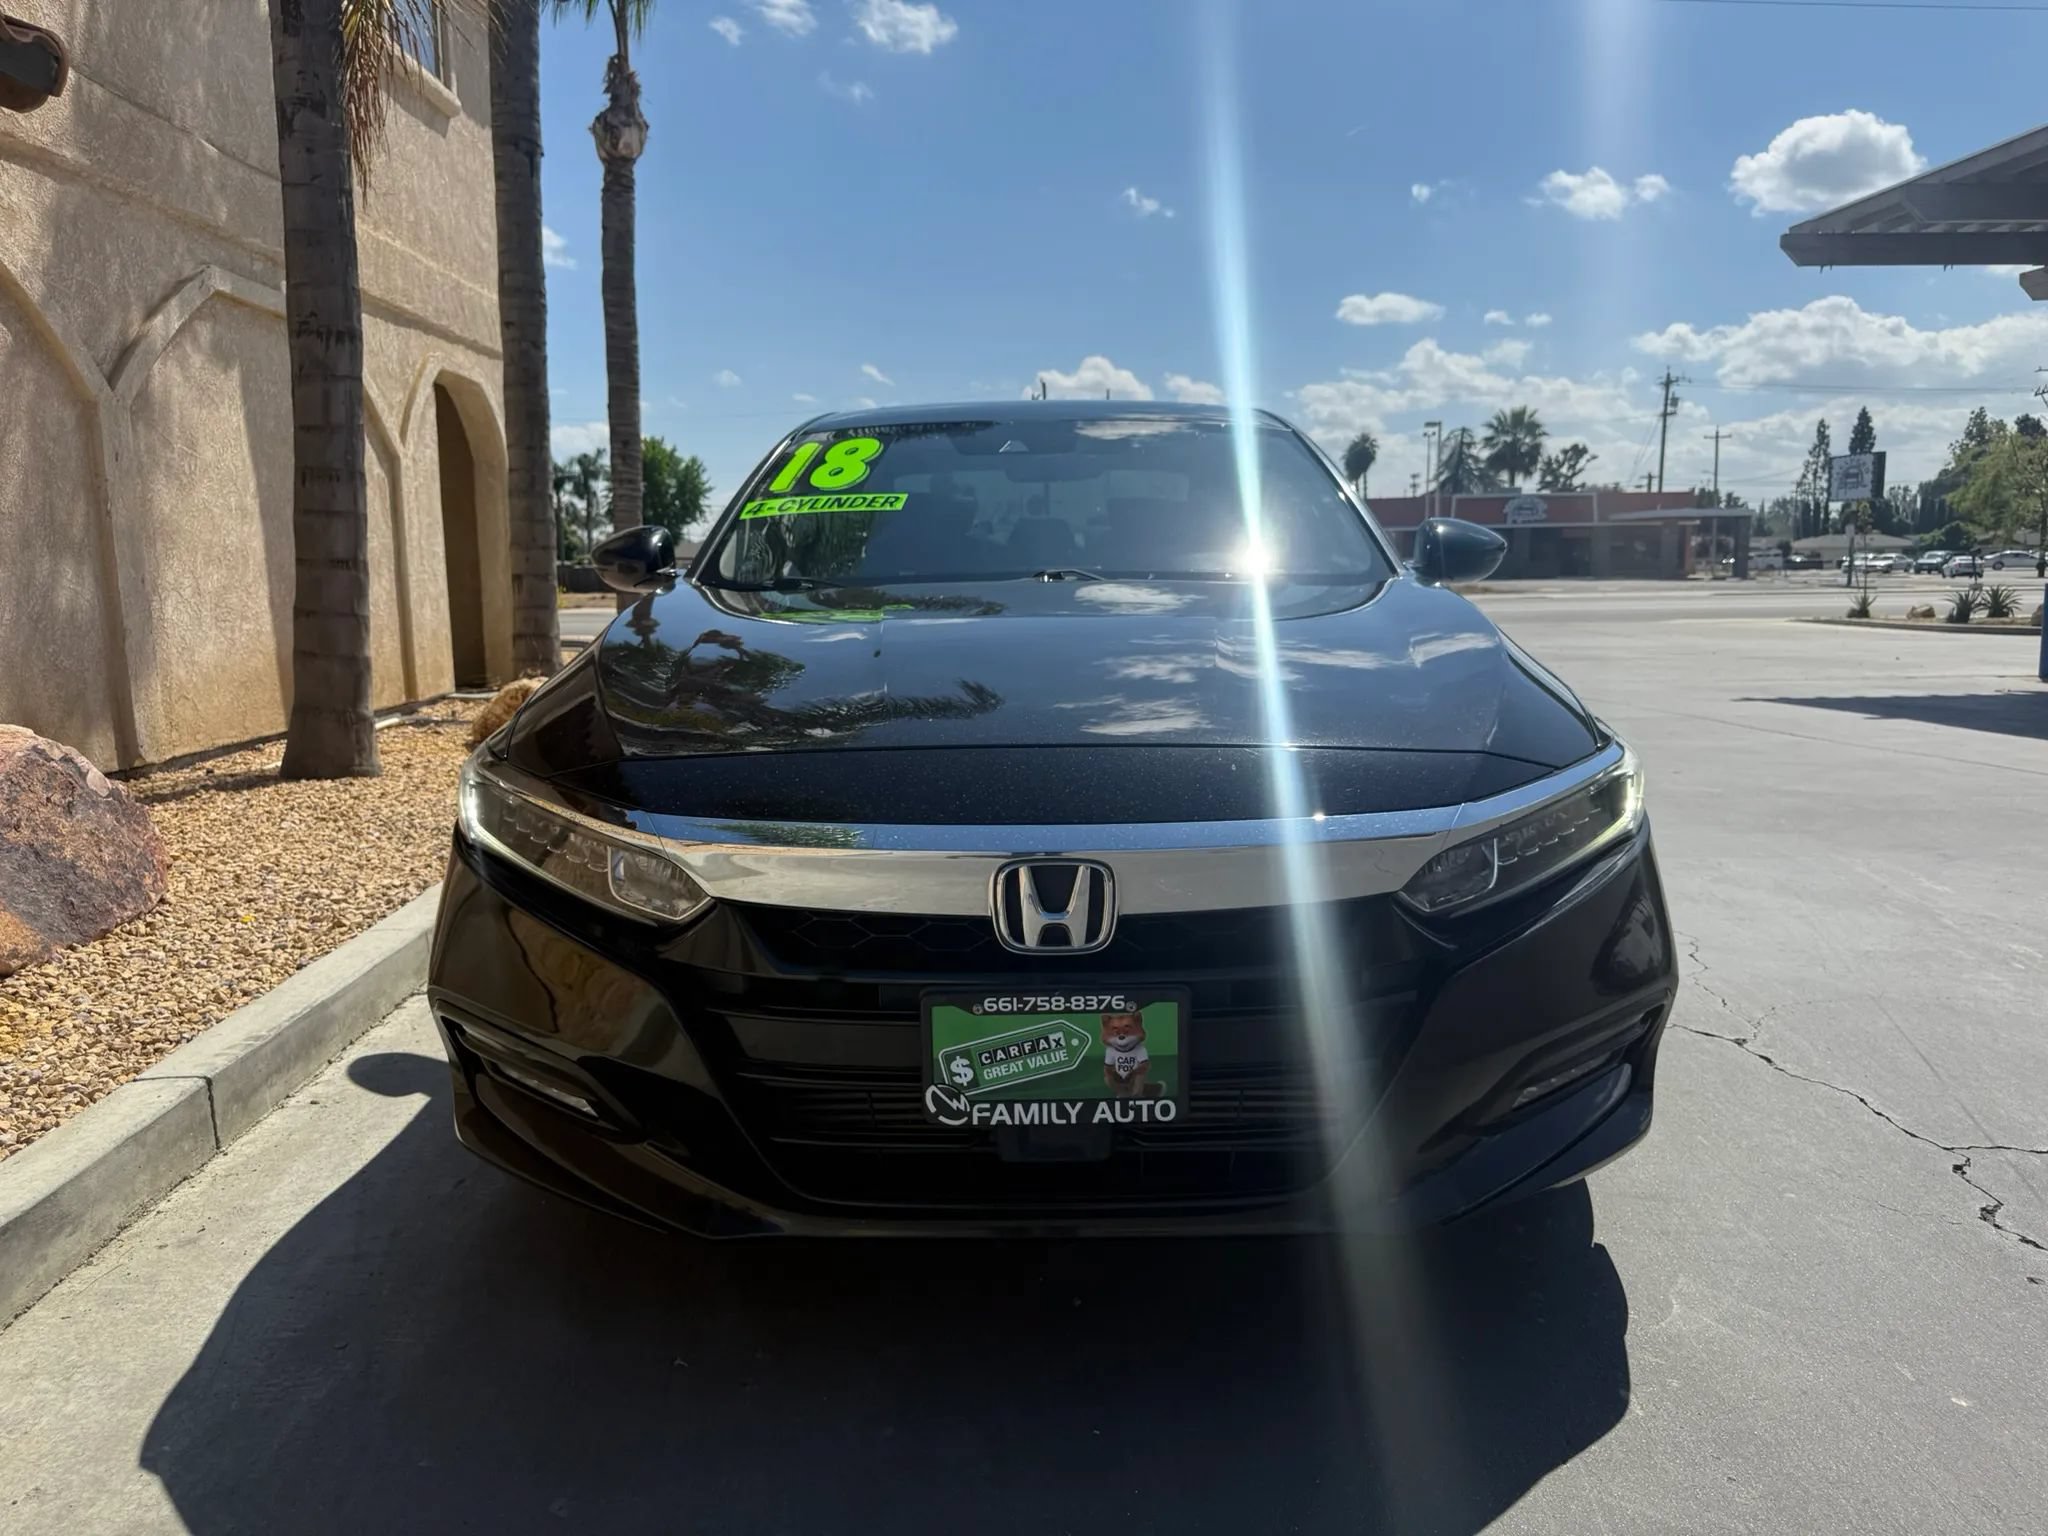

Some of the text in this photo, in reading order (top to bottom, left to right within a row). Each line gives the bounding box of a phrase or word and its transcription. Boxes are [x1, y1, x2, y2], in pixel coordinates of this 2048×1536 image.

[769, 437, 884, 493] 18
[745, 496, 900, 516] 4-CYLINDER
[983, 996, 1125, 1012] 661-758-8376
[980, 1037, 1064, 1065] CARFAX
[1117, 1056, 1136, 1066] CAR
[983, 1050, 1069, 1080] GREAT VALUE
[1117, 1064, 1136, 1073] FOX
[972, 1099, 1177, 1126] FAMILY AUTO
